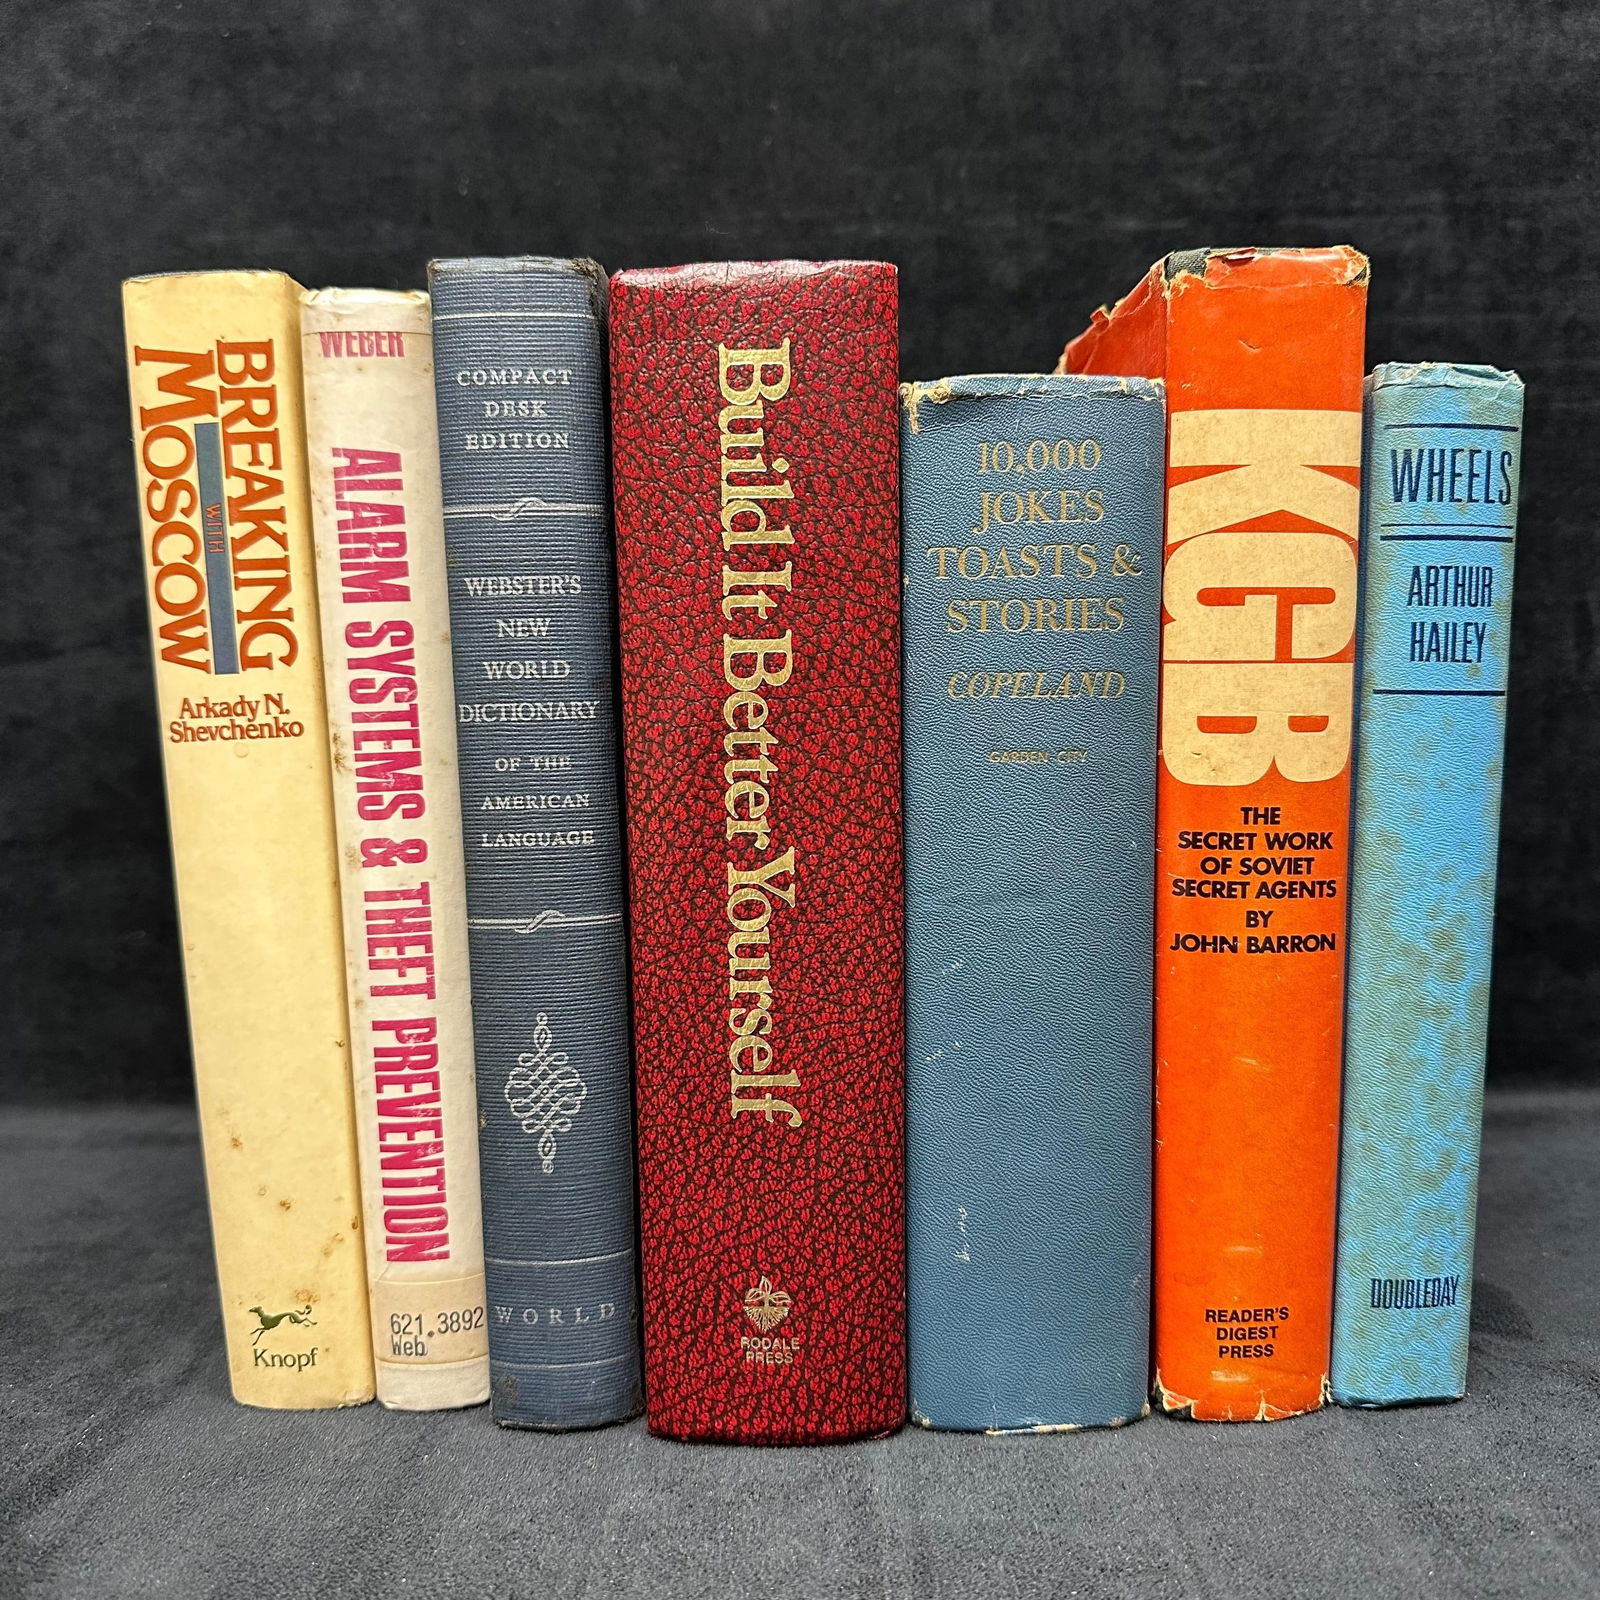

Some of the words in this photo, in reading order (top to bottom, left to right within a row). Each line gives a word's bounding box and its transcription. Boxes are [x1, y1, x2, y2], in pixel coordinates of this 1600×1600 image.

[456, 368, 572, 388] COMPACT
[483, 400, 548, 419] DESK
[465, 431, 570, 451] EDITION
[718, 337, 795, 553] Build
[977, 439, 1102, 478] 10,000
[1389, 448, 1513, 505] WHEELS
[135, 345, 219, 675] MOSCOW
[217, 339, 299, 672] BREAKING
[973, 489, 1105, 534] JOKES
[205, 503, 225, 554] WITH
[332, 447, 412, 604] ALARM
[927, 544, 1099, 580] TOASTS
[1111, 543, 1143, 577] &
[464, 575, 583, 597] WEBSTER'S
[721, 560, 794, 621] It
[1162, 408, 1362, 787] KGB
[1406, 564, 1493, 607] ARTHUR
[496, 618, 551, 638] NEW
[946, 598, 1125, 633] STORIES
[1409, 621, 1487, 665] HAILEY
[483, 659, 570, 680] WORLD
[947, 671, 1127, 700] COPELAND
[179, 694, 260, 720] Arkady
[263, 693, 290, 716] N.
[458, 700, 600, 723] DICTIONARY
[169, 717, 304, 743] Shevchenko
[345, 619, 426, 822] SYSTEMS
[723, 628, 793, 850] Better
[494, 755, 524, 773] OF
[530, 754, 572, 772] THE
[480, 793, 591, 811] AMERICAN
[1240, 806, 1281, 826] THE
[481, 829, 596, 848] LANGUAGE
[1177, 831, 1258, 851] SECRET
[1263, 831, 1334, 850] WORK
[359, 836, 429, 868] &
[1199, 857, 1233, 875] OF
[1237, 857, 1315, 875] SOVIET
[1171, 879, 1253, 899] SECRET
[1254, 879, 1337, 898] AGENTS
[1244, 910, 1274, 928] BY
[364, 881, 437, 1000] THEFT
[1169, 933, 1239, 954] JOHN
[1245, 933, 1336, 953] BARRON
[727, 846, 802, 1128] Yourself
[371, 1016, 451, 1263] PREVENTION
[1370, 1275, 1461, 1310] DOUBLEDAY
[390, 1306, 484, 1338] 621.3892
[495, 1302, 615, 1325] WORLD
[1204, 1306, 1290, 1324] READER'S
[391, 1334, 426, 1357] Web
[740, 1336, 800, 1350] RODALE
[1216, 1325, 1278, 1342] DIGEST
[253, 1346, 319, 1372] Knopf
[745, 1350, 794, 1364] PRESS
[1218, 1343, 1275, 1359] PRESS
